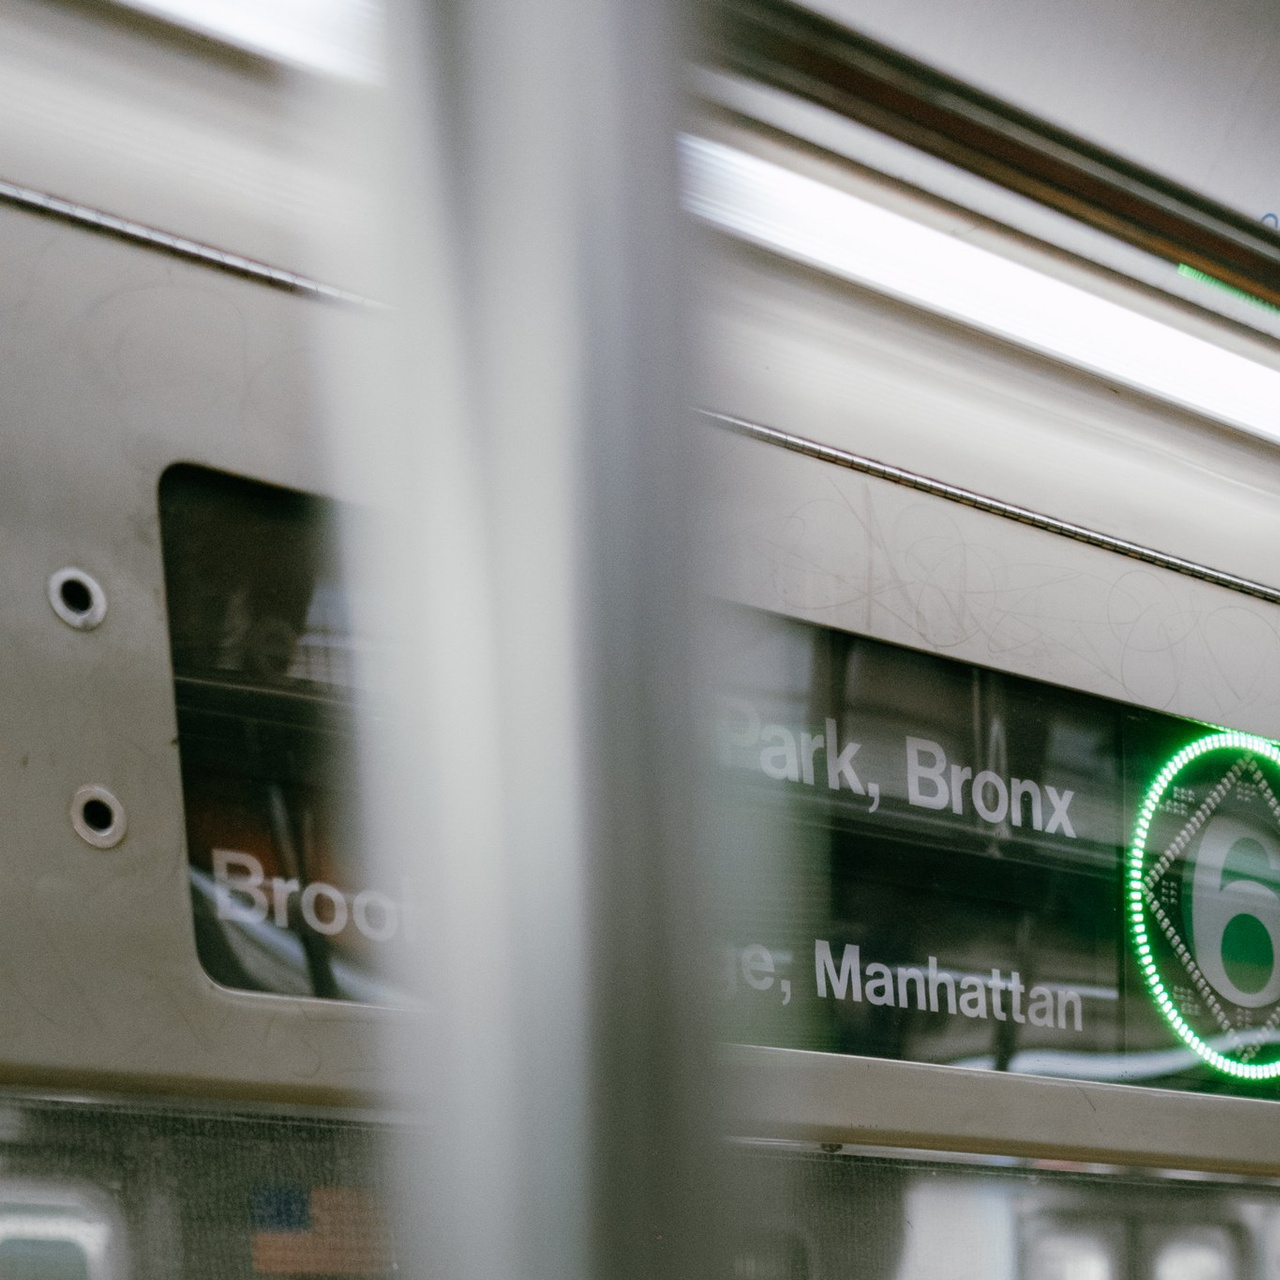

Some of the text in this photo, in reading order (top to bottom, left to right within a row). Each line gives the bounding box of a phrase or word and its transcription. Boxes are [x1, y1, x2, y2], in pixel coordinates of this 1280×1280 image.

[905, 735, 1077, 839] Bronx
[210, 847, 402, 944] Broo
[814, 938, 1084, 1032] Manhattan
